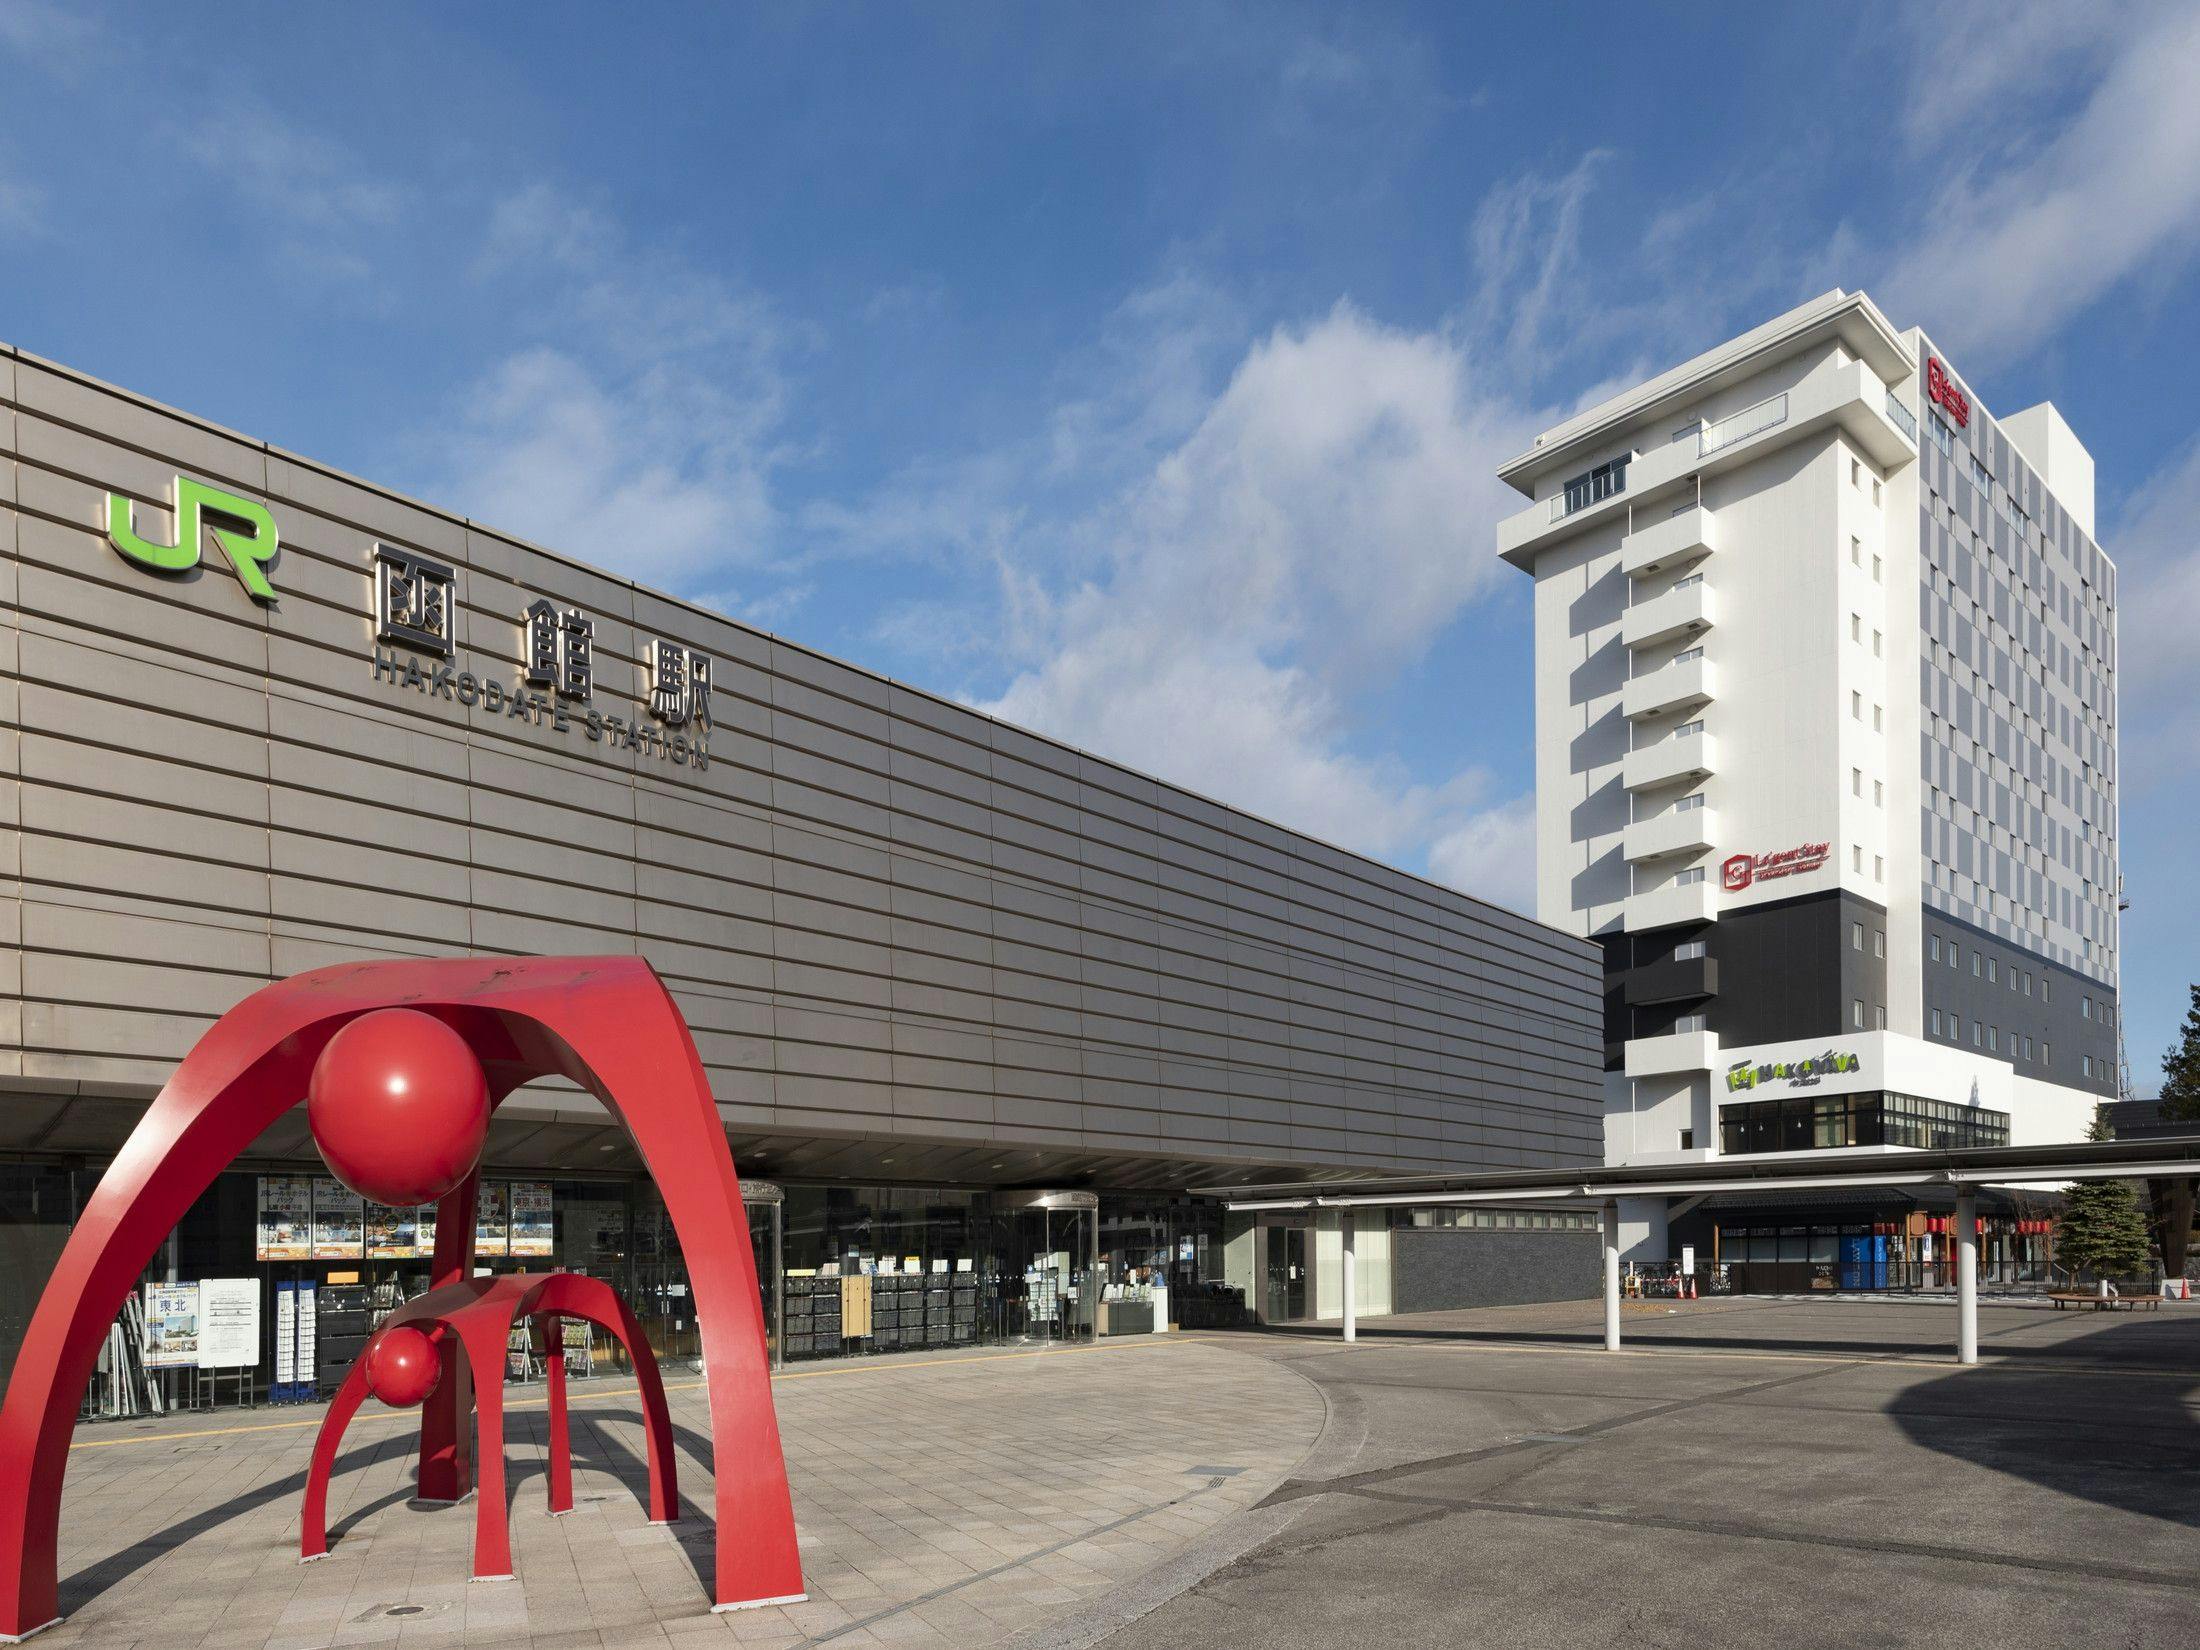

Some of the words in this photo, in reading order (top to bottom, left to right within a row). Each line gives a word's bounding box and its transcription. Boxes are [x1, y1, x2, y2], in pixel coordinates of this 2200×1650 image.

[105, 474, 279, 602] JR
[373, 541, 714, 735] 函館駅
[373, 645, 571, 733] HAKODATE
[584, 709, 711, 771] STATION
[160, 1298, 187, 1312] 東北
